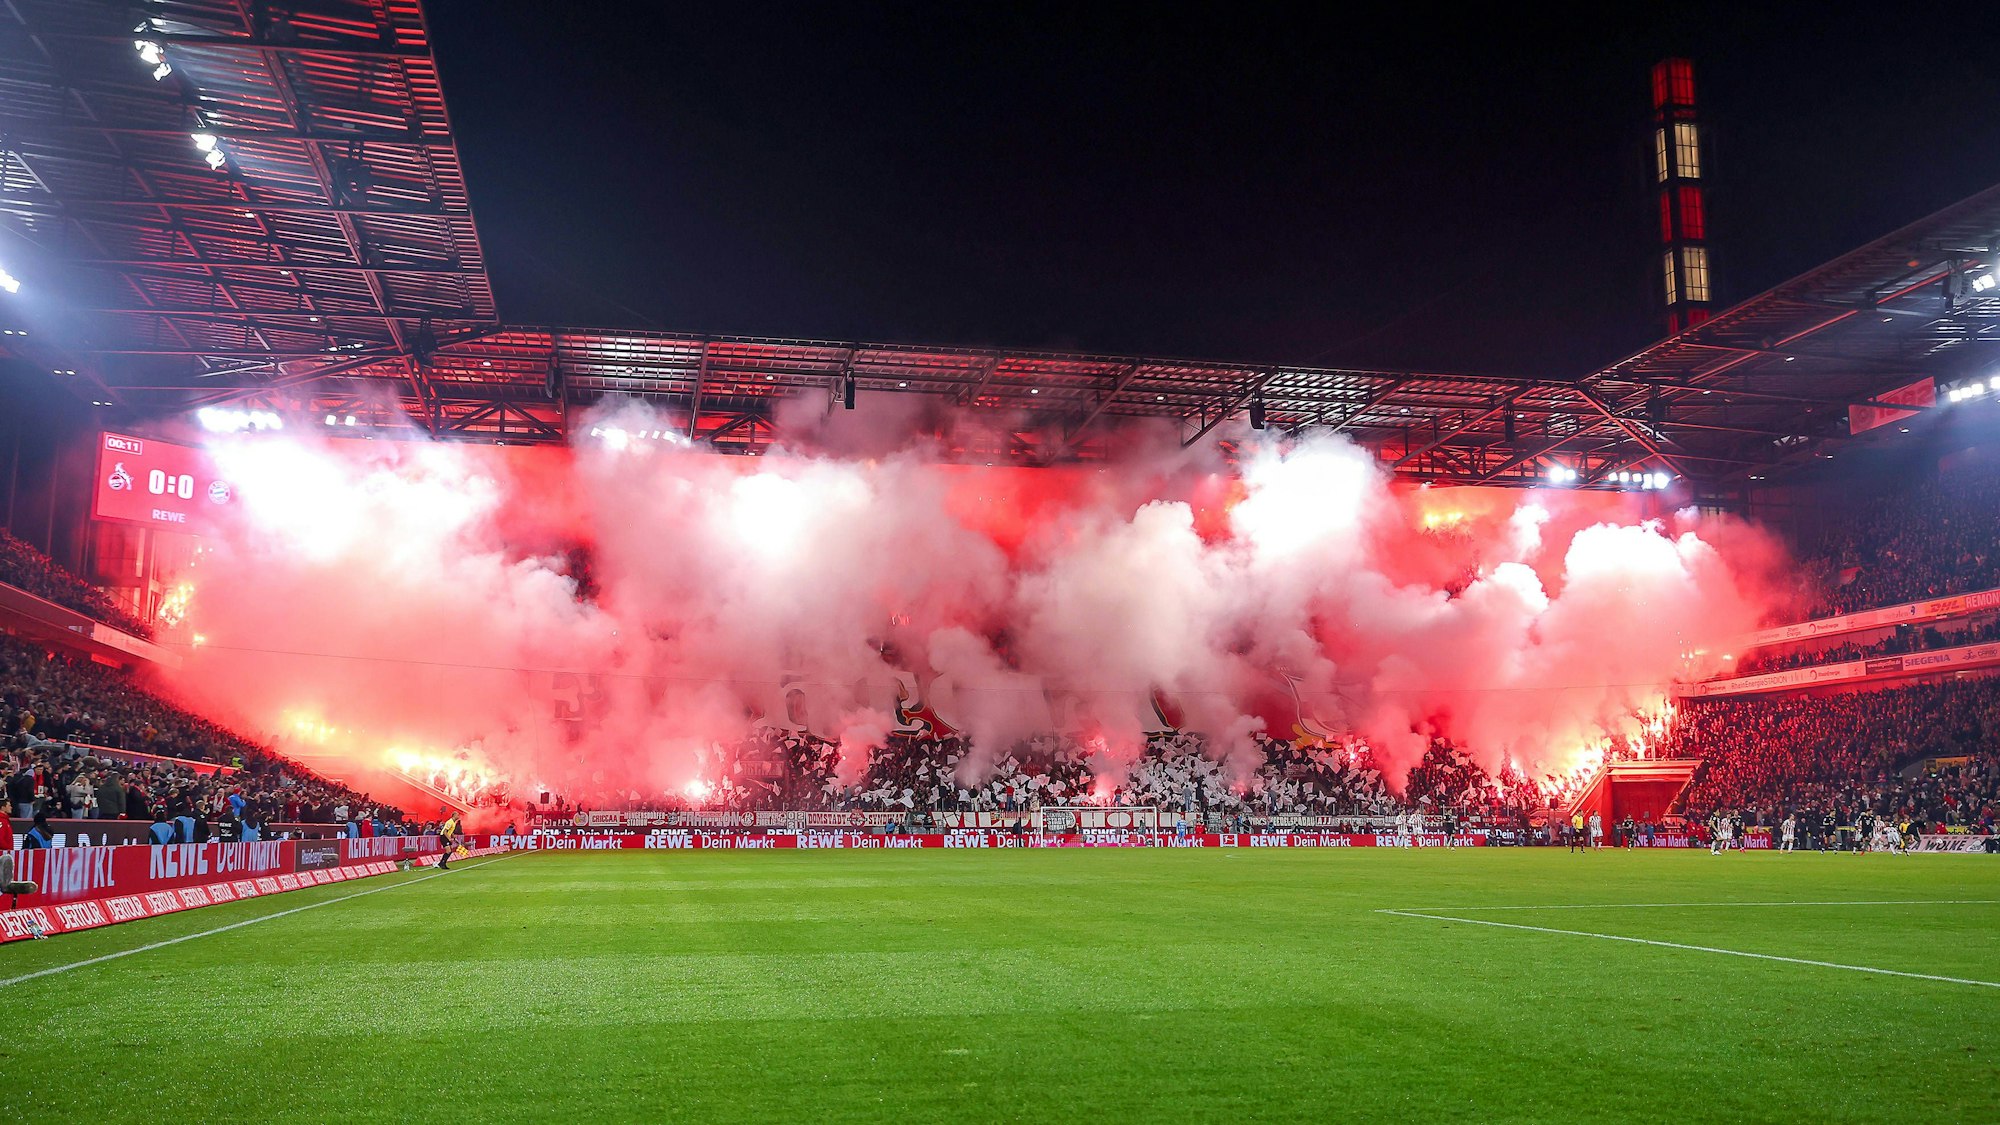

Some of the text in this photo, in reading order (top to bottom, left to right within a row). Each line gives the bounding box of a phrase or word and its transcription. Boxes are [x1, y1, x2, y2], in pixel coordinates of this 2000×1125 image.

[108, 438, 139, 452] 00:11
[148, 469, 194, 500] 0:0
[152, 509, 186, 522] REWE
[1930, 600, 1960, 613] DHL
[1965, 591, 2000, 609] REMON
[1904, 654, 1951, 667] SIEGENIA
[808, 813, 847, 825] DOMSTADT
[490, 834, 538, 850] REWE
[546, 834, 577, 850] Dein
[580, 835, 623, 850] Markt
[644, 834, 775, 849] REWE Dein Markt
[796, 834, 923, 849] REWE Dein Markt
[943, 834, 990, 849] REWE
[1250, 835, 1351, 847] REWE Dein Markt
[1419, 835, 1440, 847] Dein
[1495, 829, 1515, 840] Dein
[1652, 833, 1666, 846] Dein
[1667, 834, 1689, 847] Markt
[1744, 834, 1769, 849] Markt
[1925, 840, 1967, 851] WOLKE
[42, 846, 117, 895] Markt
[145, 891, 181, 914] DERTOUR
[178, 887, 211, 908] DERTOUR
[55, 901, 107, 930] DERTOUR
[105, 895, 148, 921] DERTOUR
[0, 907, 54, 938] DERTOUR
